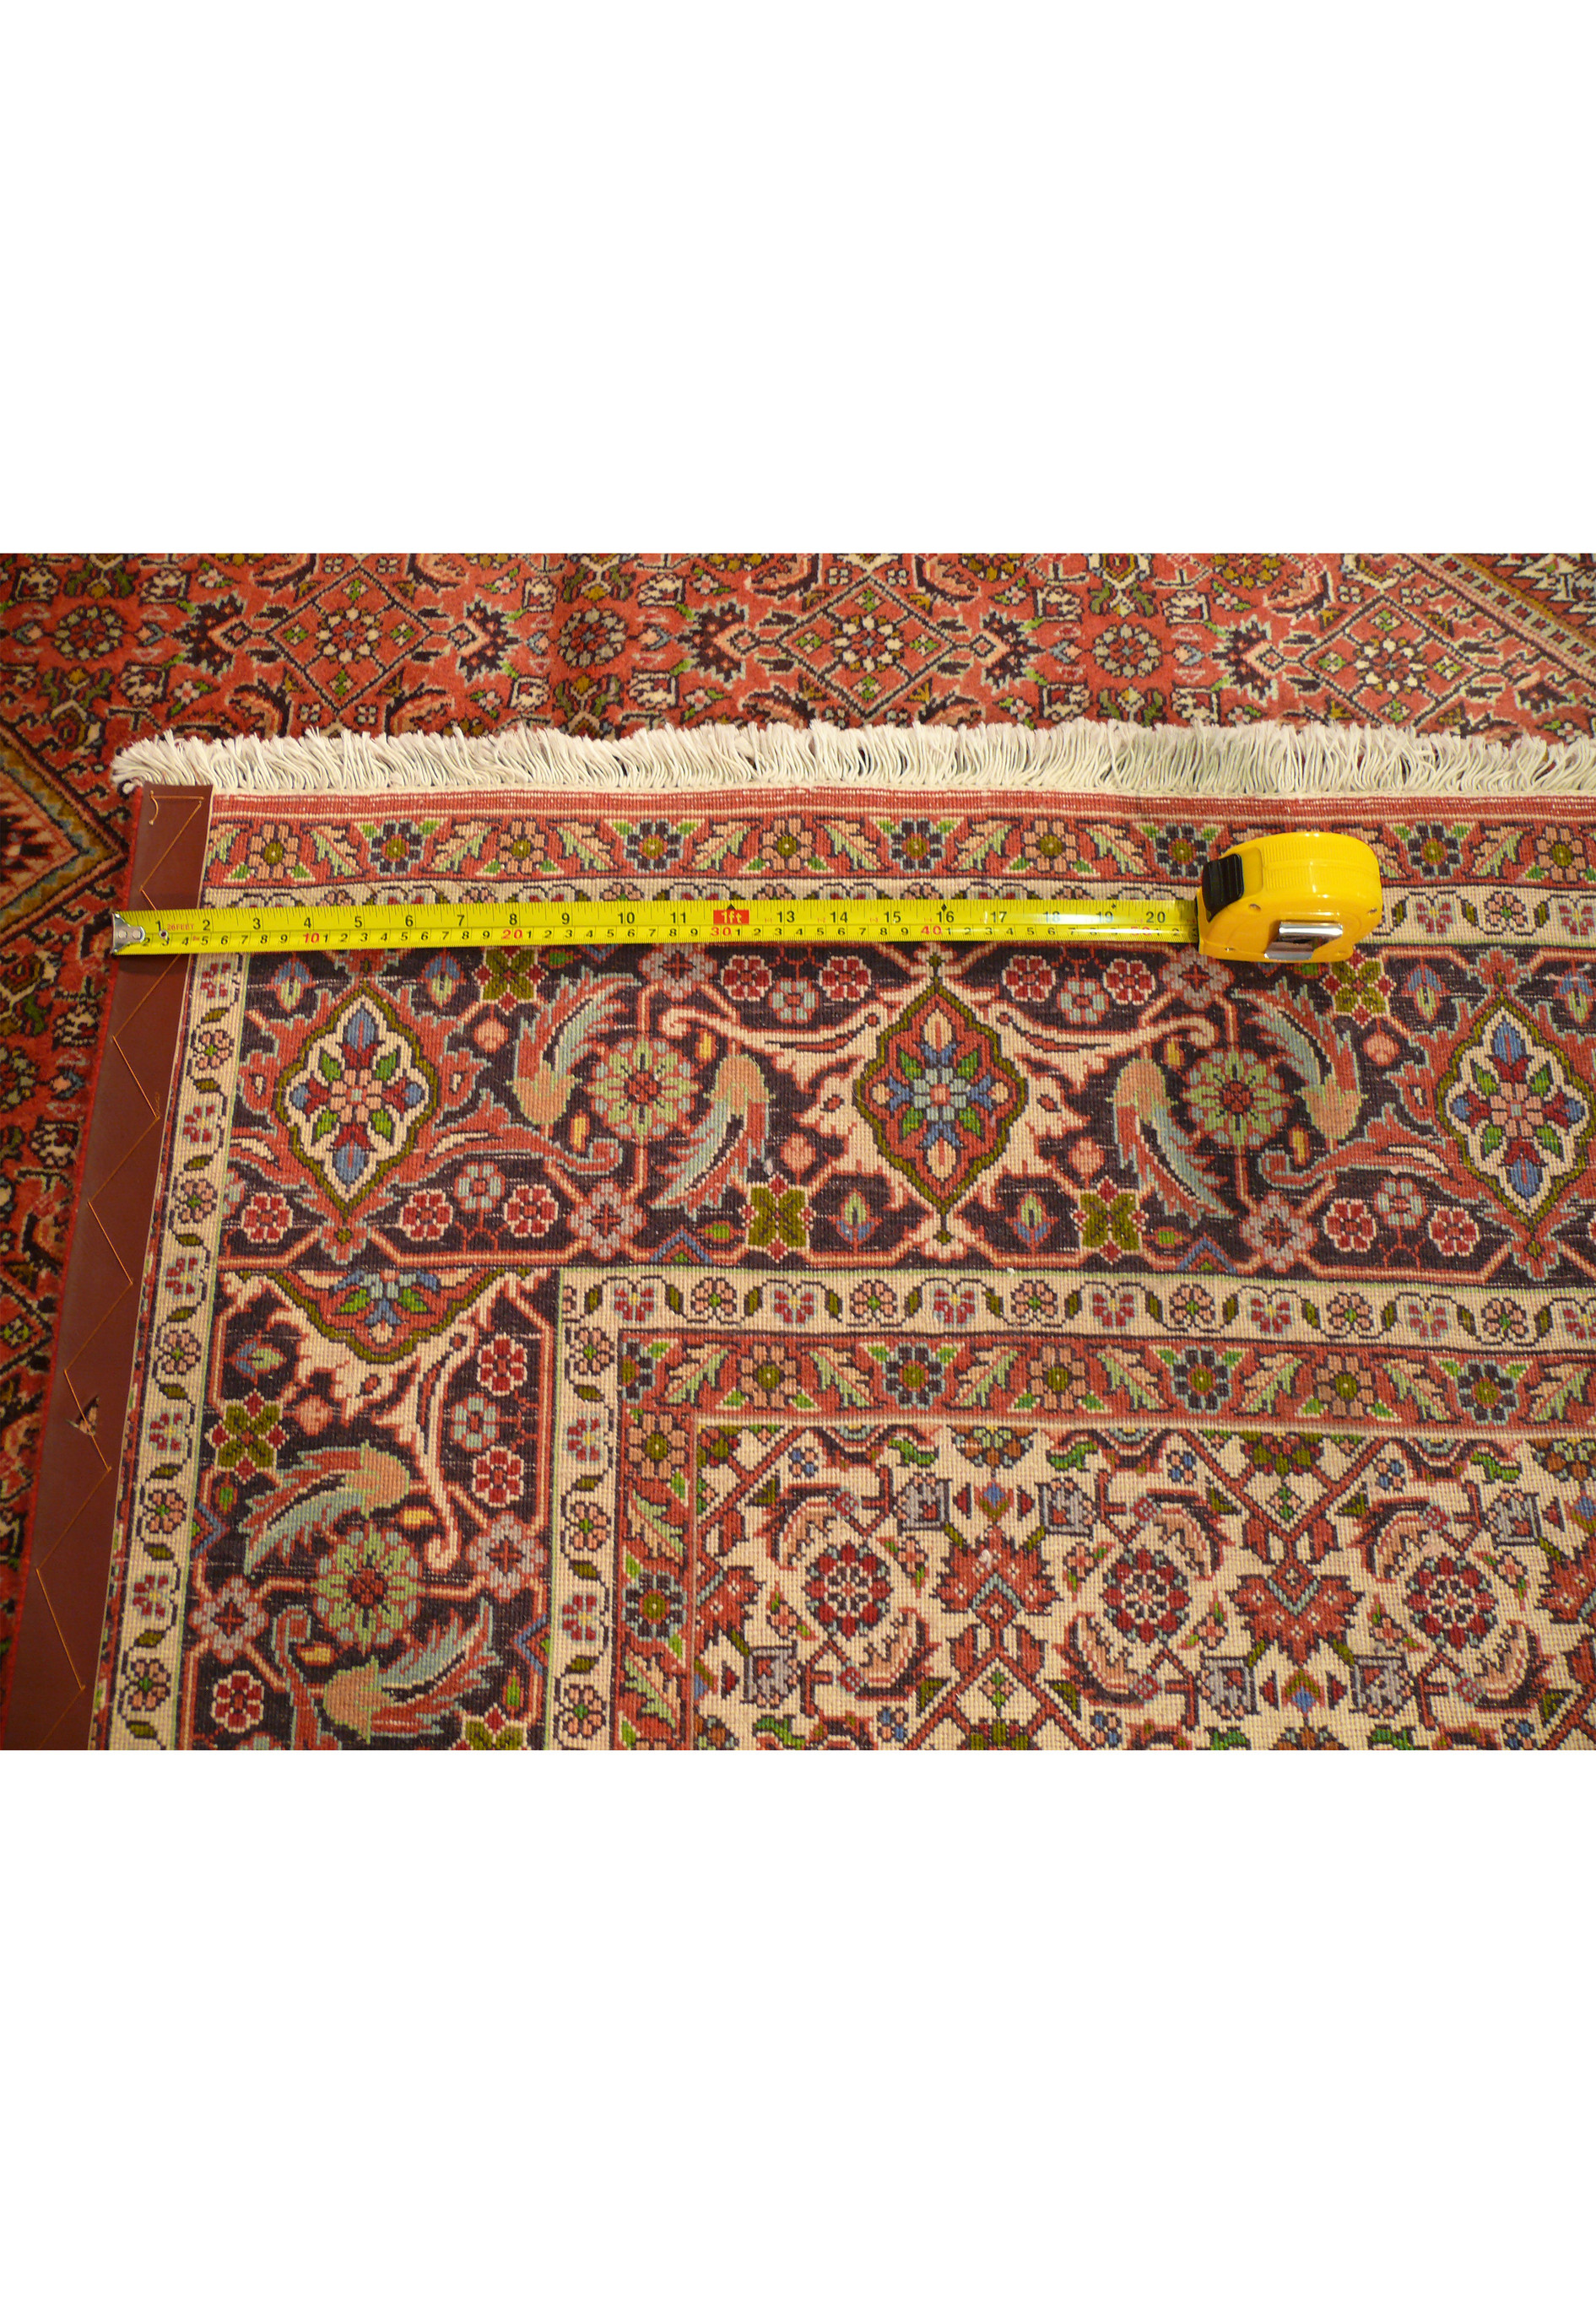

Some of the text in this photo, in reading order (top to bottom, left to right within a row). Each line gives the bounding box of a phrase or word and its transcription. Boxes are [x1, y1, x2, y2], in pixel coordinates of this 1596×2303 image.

[155, 921, 161, 932] 1
[203, 920, 210, 930] 2
[253, 918, 261, 929] 3
[304, 917, 311, 928] 4
[354, 916, 362, 927] 5
[405, 916, 414, 927] 6
[457, 915, 465, 926] 7
[509, 913, 517, 925] 8
[561, 913, 570, 924] 9
[618, 912, 635, 924] 10
[670, 912, 686, 923] 11
[722, 911, 742, 923] 1ft
[776, 911, 795, 922] 13
[830, 911, 847, 922] 14
[884, 911, 901, 922] 15
[936, 911, 955, 922] 16
[991, 911, 1007, 922] 17
[1043, 911, 1060, 922] 18
[1096, 911, 1113, 922] 19
[1146, 911, 1166, 923] 20
[181, 937, 189, 945] 4
[201, 936, 208, 945] 5
[220, 936, 229, 944] 6
[241, 935, 248, 943] 7
[260, 935, 268, 943] 8
[280, 934, 288, 943] 9
[303, 933, 319, 943] 10
[323, 934, 328, 943] 1
[340, 933, 348, 942] 2
[360, 933, 368, 942] 3
[381, 933, 387, 941] 4
[401, 933, 408, 941] 5
[421, 932, 429, 940] 6
[462, 931, 469, 939] 8
[482, 931, 490, 939] 9
[501, 929, 522, 939] 20
[544, 930, 552, 938] 2
[586, 929, 593, 938] 4
[669, 928, 677, 937] 8
[690, 928, 698, 937] 9
[711, 927, 731, 936] 30
[921, 926, 942, 935] 40
